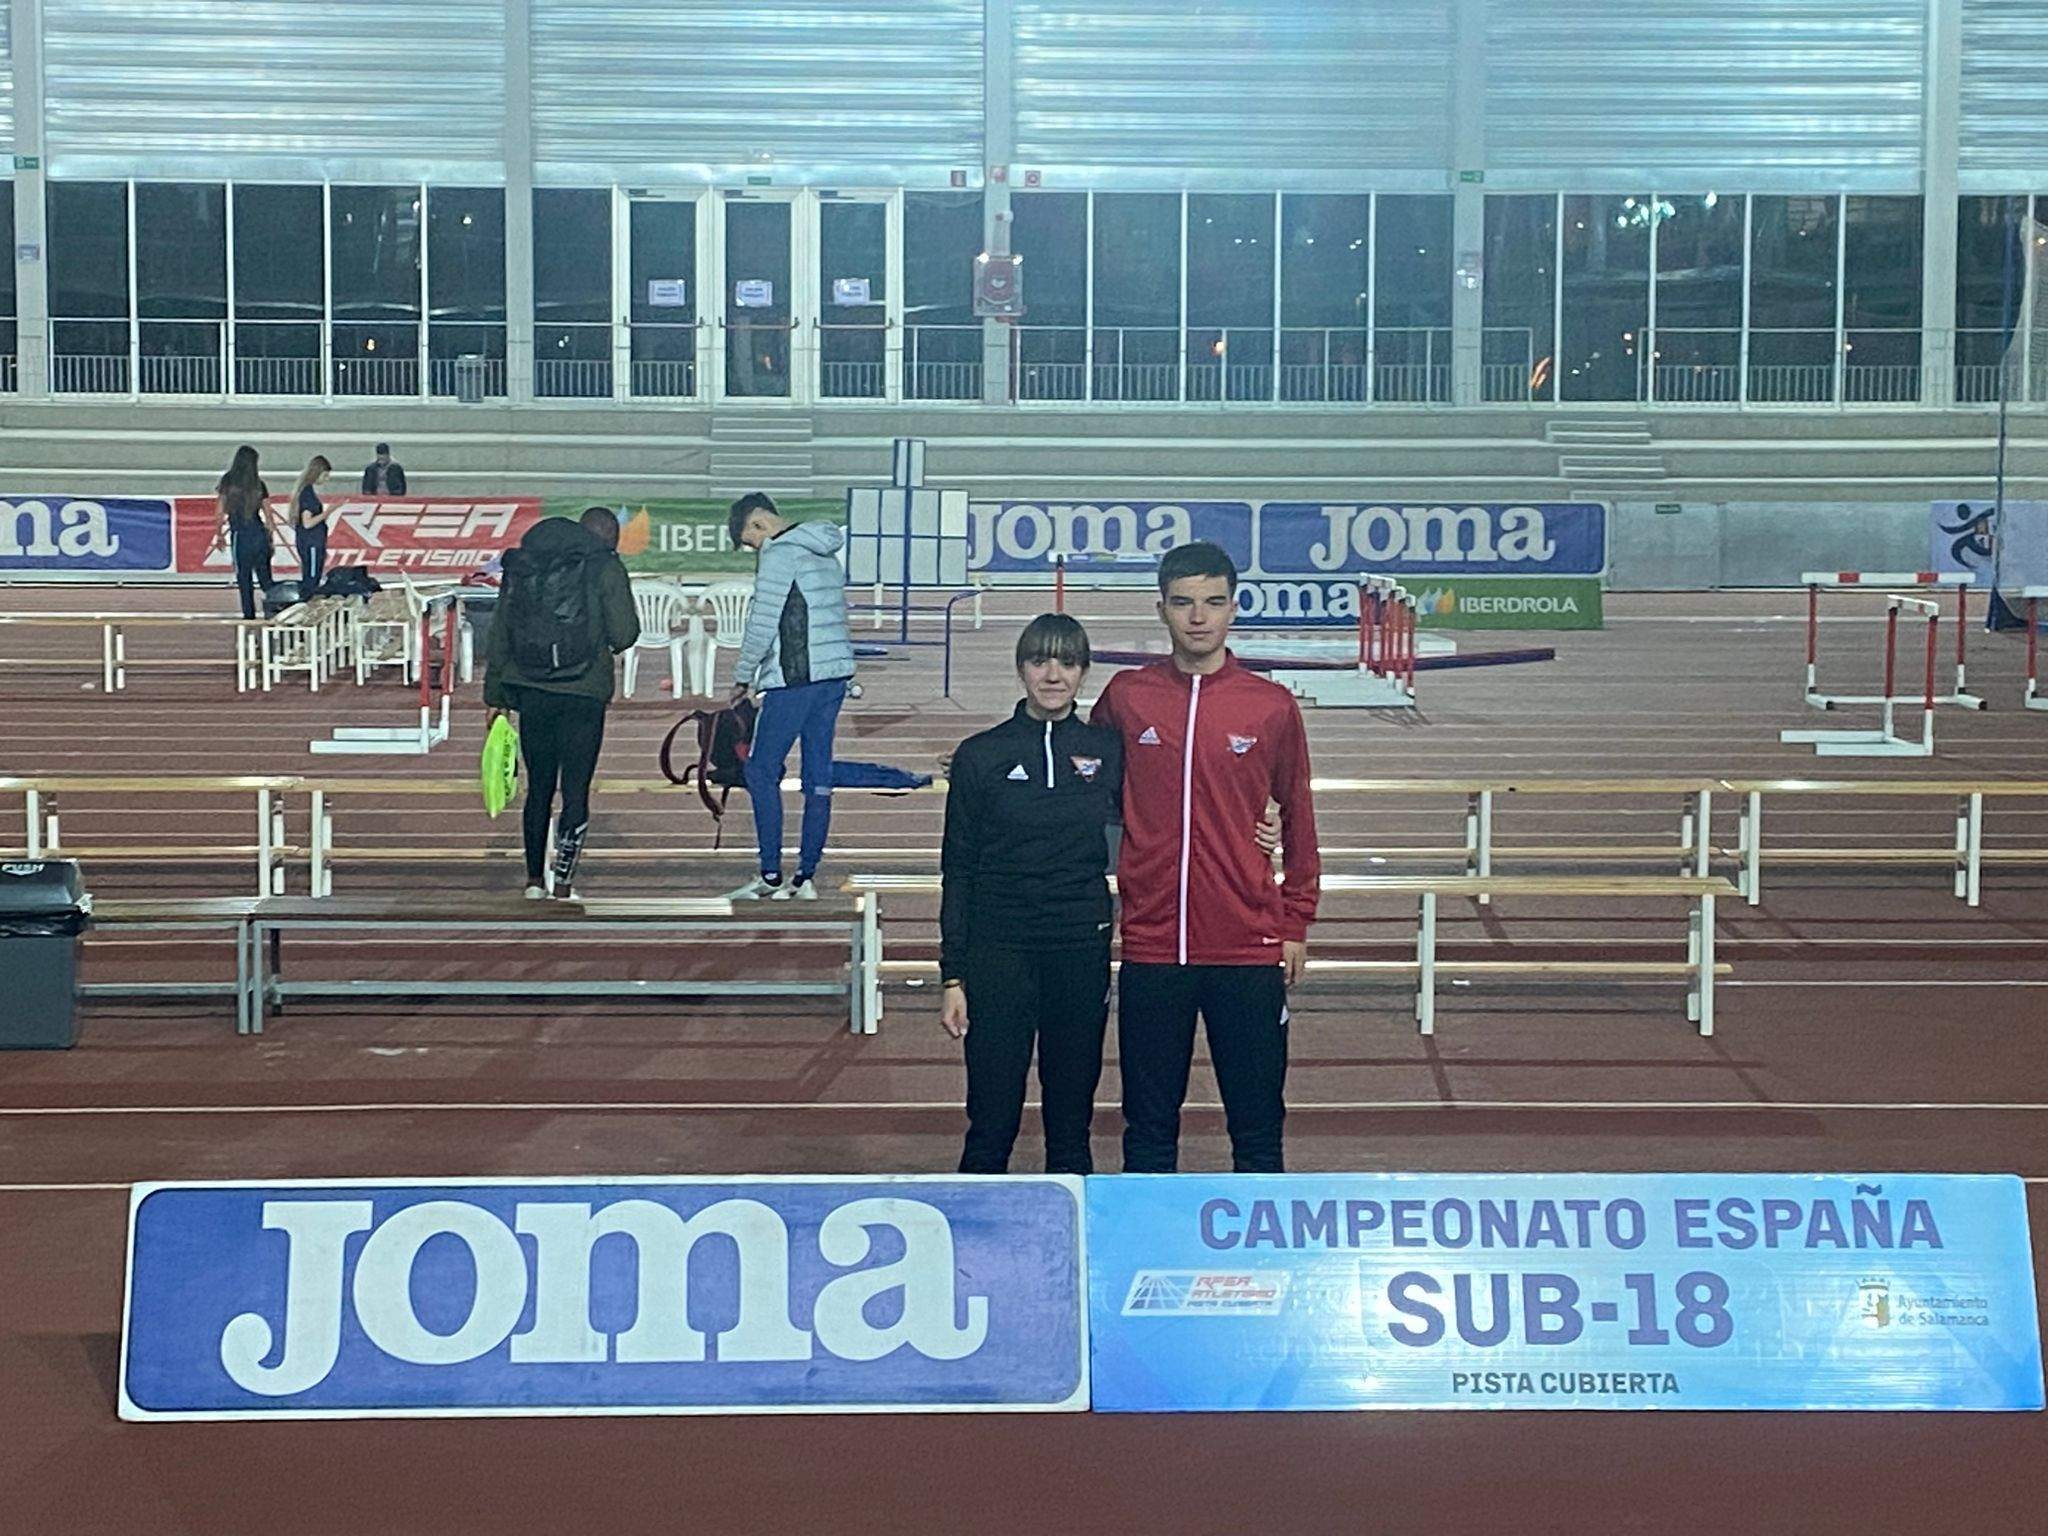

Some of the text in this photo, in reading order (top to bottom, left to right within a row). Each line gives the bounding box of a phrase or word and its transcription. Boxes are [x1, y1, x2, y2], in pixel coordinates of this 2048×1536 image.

[327, 503, 520, 547] RFEA
[1236, 582, 1361, 618] oma
[1460, 597, 1578, 613] IBERDROLA
[1201, 1184, 1945, 1251] CAMPEONATO ESPAÑA
[1386, 1270, 1735, 1349] SUB-18
[1898, 1294, 1988, 1310] Ayuntamiento
[1899, 1311, 1990, 1326] de Salamanca
[1452, 1372, 1680, 1394] PISTA CUBIERTA
